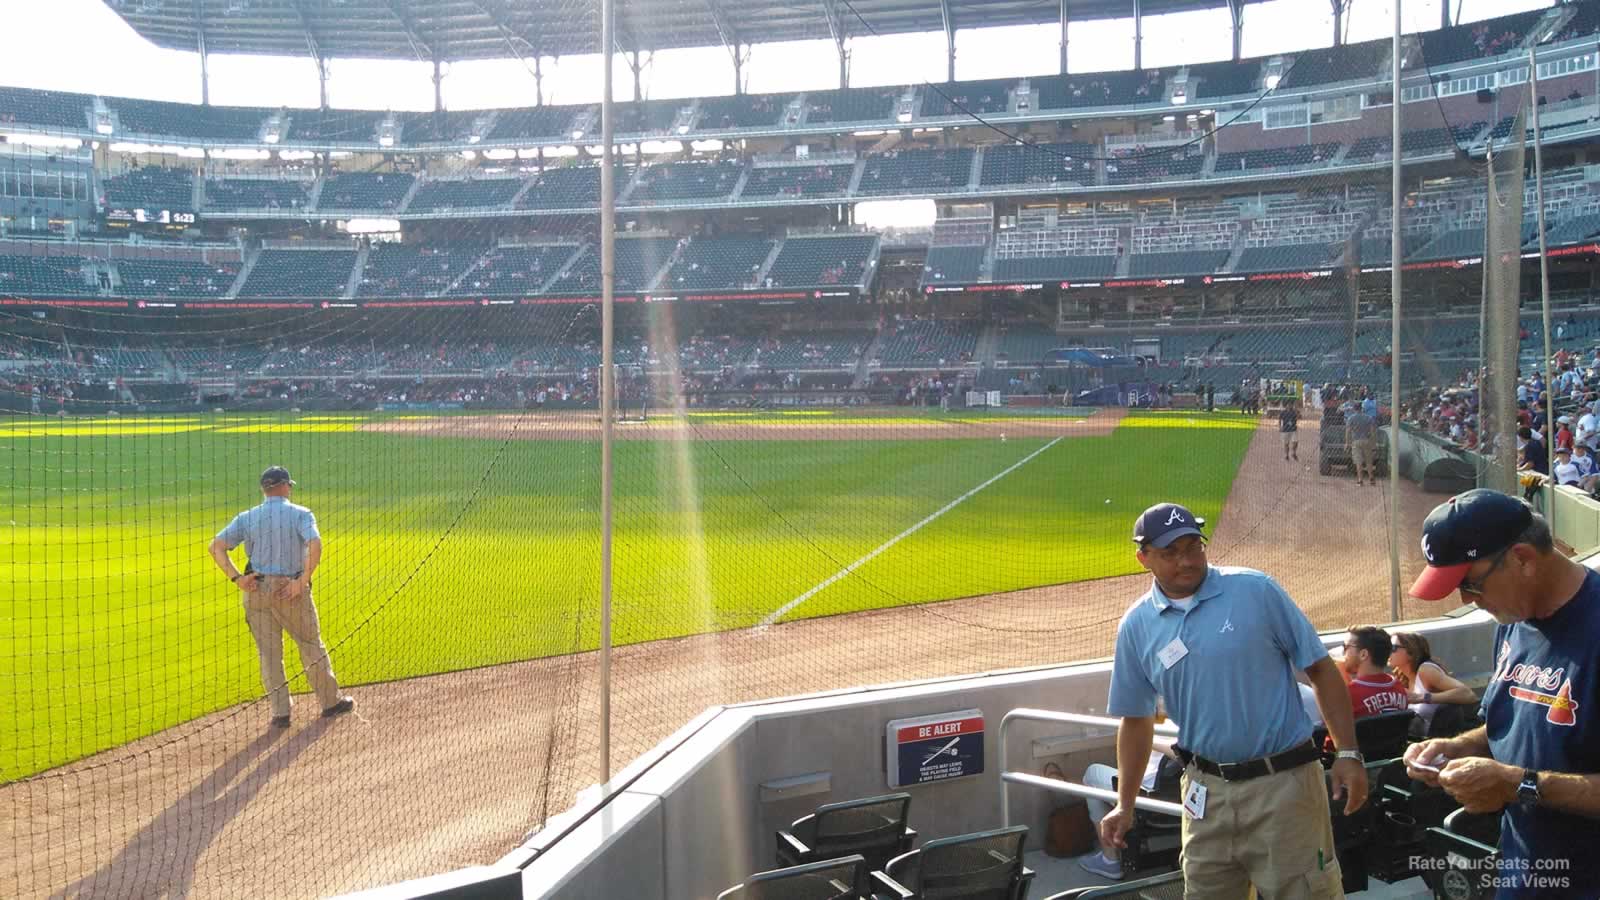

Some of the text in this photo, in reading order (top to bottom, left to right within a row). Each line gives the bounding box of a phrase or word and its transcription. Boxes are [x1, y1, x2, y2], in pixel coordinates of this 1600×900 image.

[1164, 507, 1185, 526] A
[1219, 618, 1234, 633] A
[1363, 691, 1407, 713] FREEMAN
[919, 722, 962, 738] BE ALERT
